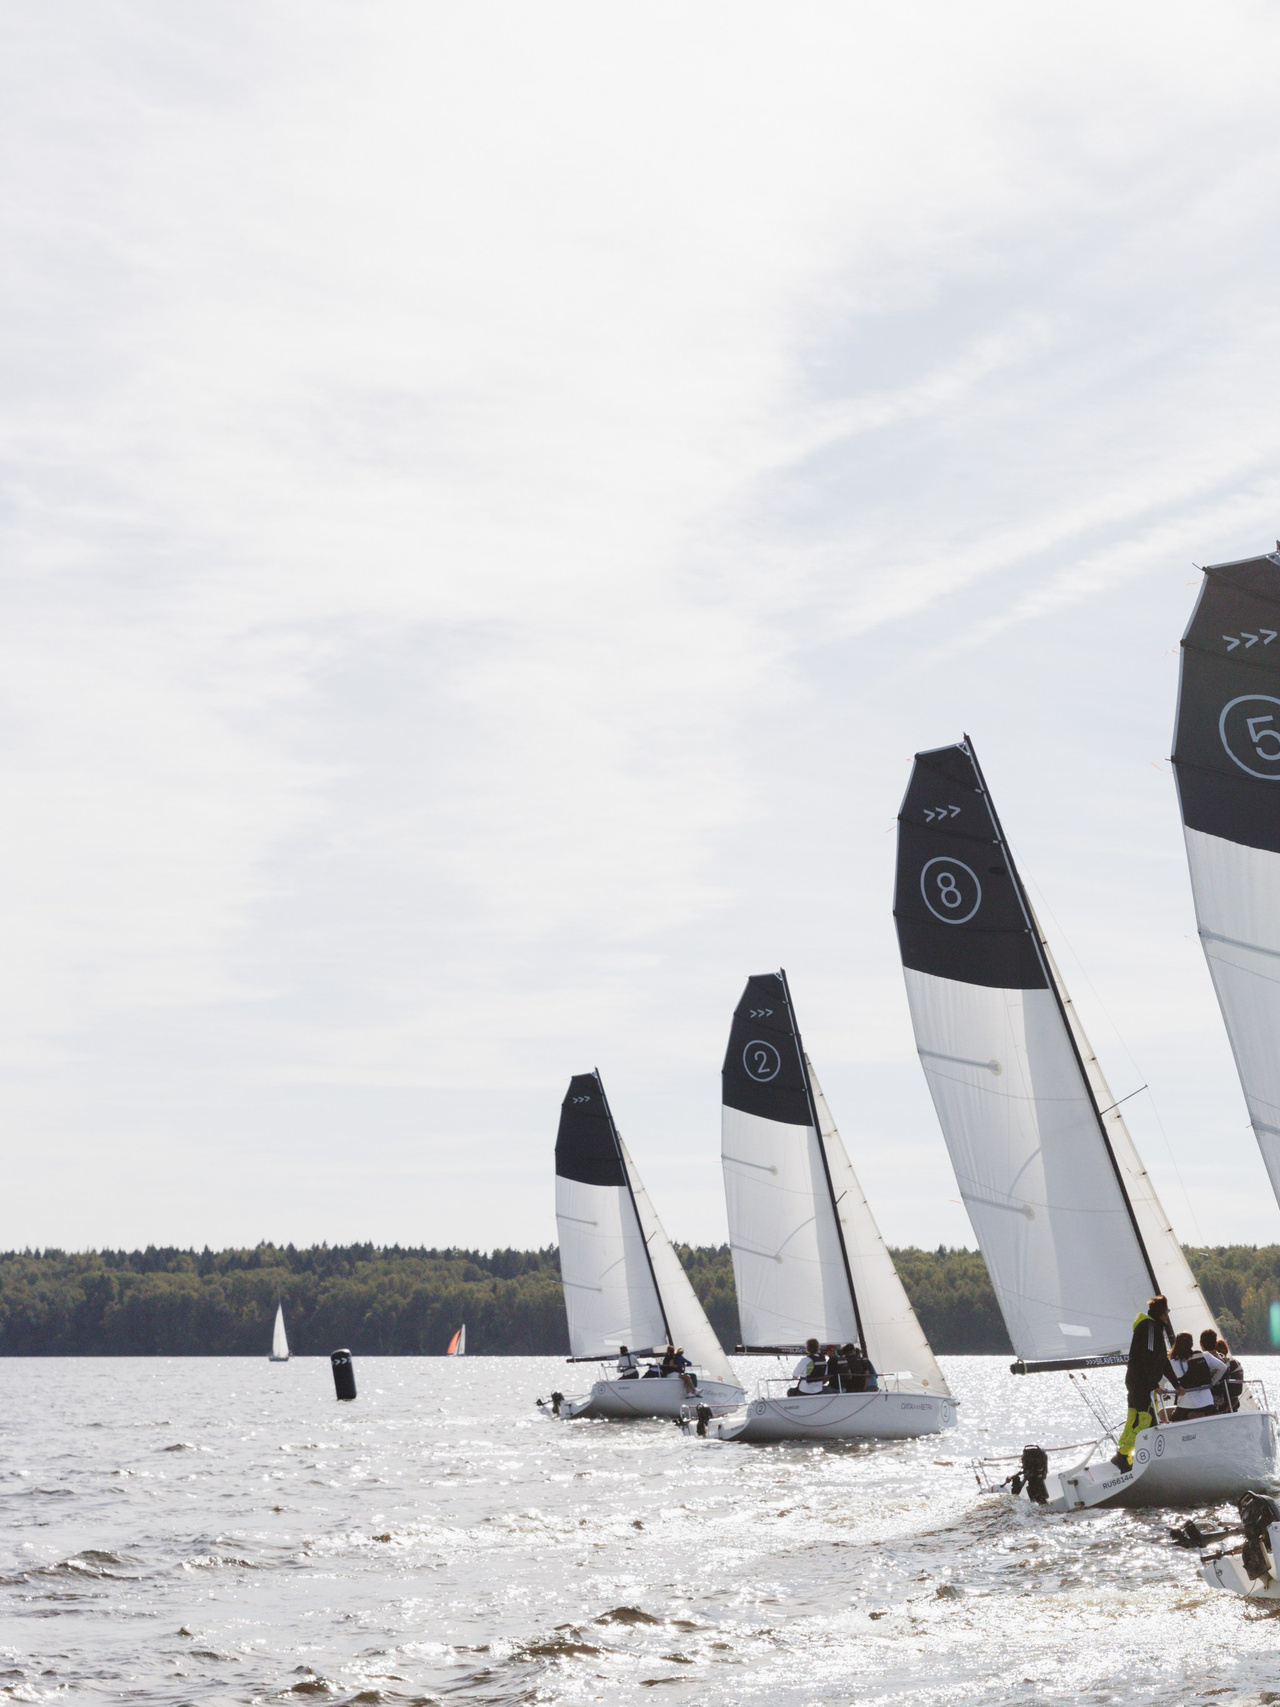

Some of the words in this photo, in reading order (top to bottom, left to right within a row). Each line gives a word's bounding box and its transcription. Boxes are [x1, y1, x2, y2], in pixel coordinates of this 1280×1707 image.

[937, 872, 962, 908] 8
[754, 1051, 770, 1073] 2
[1139, 1451, 1147, 1461] 8
[1102, 1473, 1134, 1490] RUS6144
